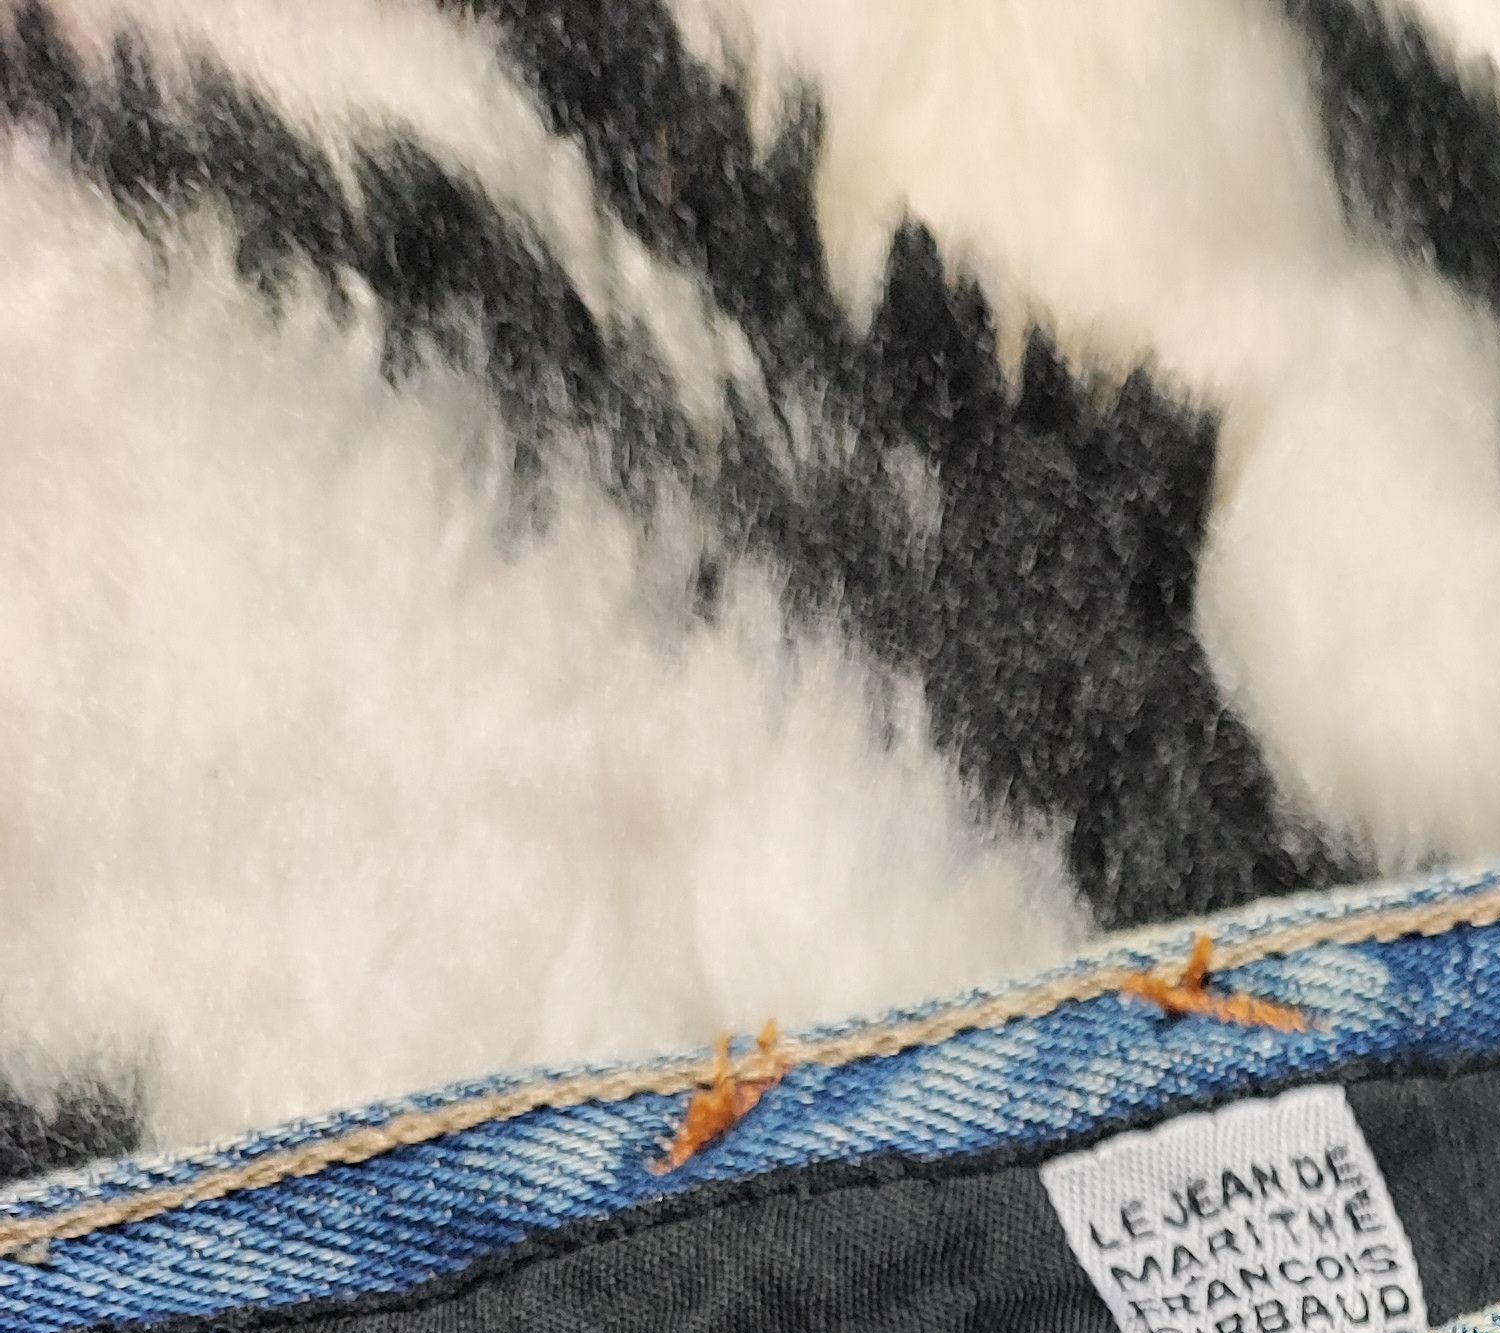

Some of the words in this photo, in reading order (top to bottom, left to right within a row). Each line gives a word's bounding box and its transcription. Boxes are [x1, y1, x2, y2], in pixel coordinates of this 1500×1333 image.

[1089, 1197, 1156, 1250] LE
[1163, 1162, 1284, 1229] JEAN
[1292, 1145, 1359, 1191] DE
[1110, 1188, 1384, 1292] MARITHE
[1128, 1243, 1400, 1318] FRANCOIS
